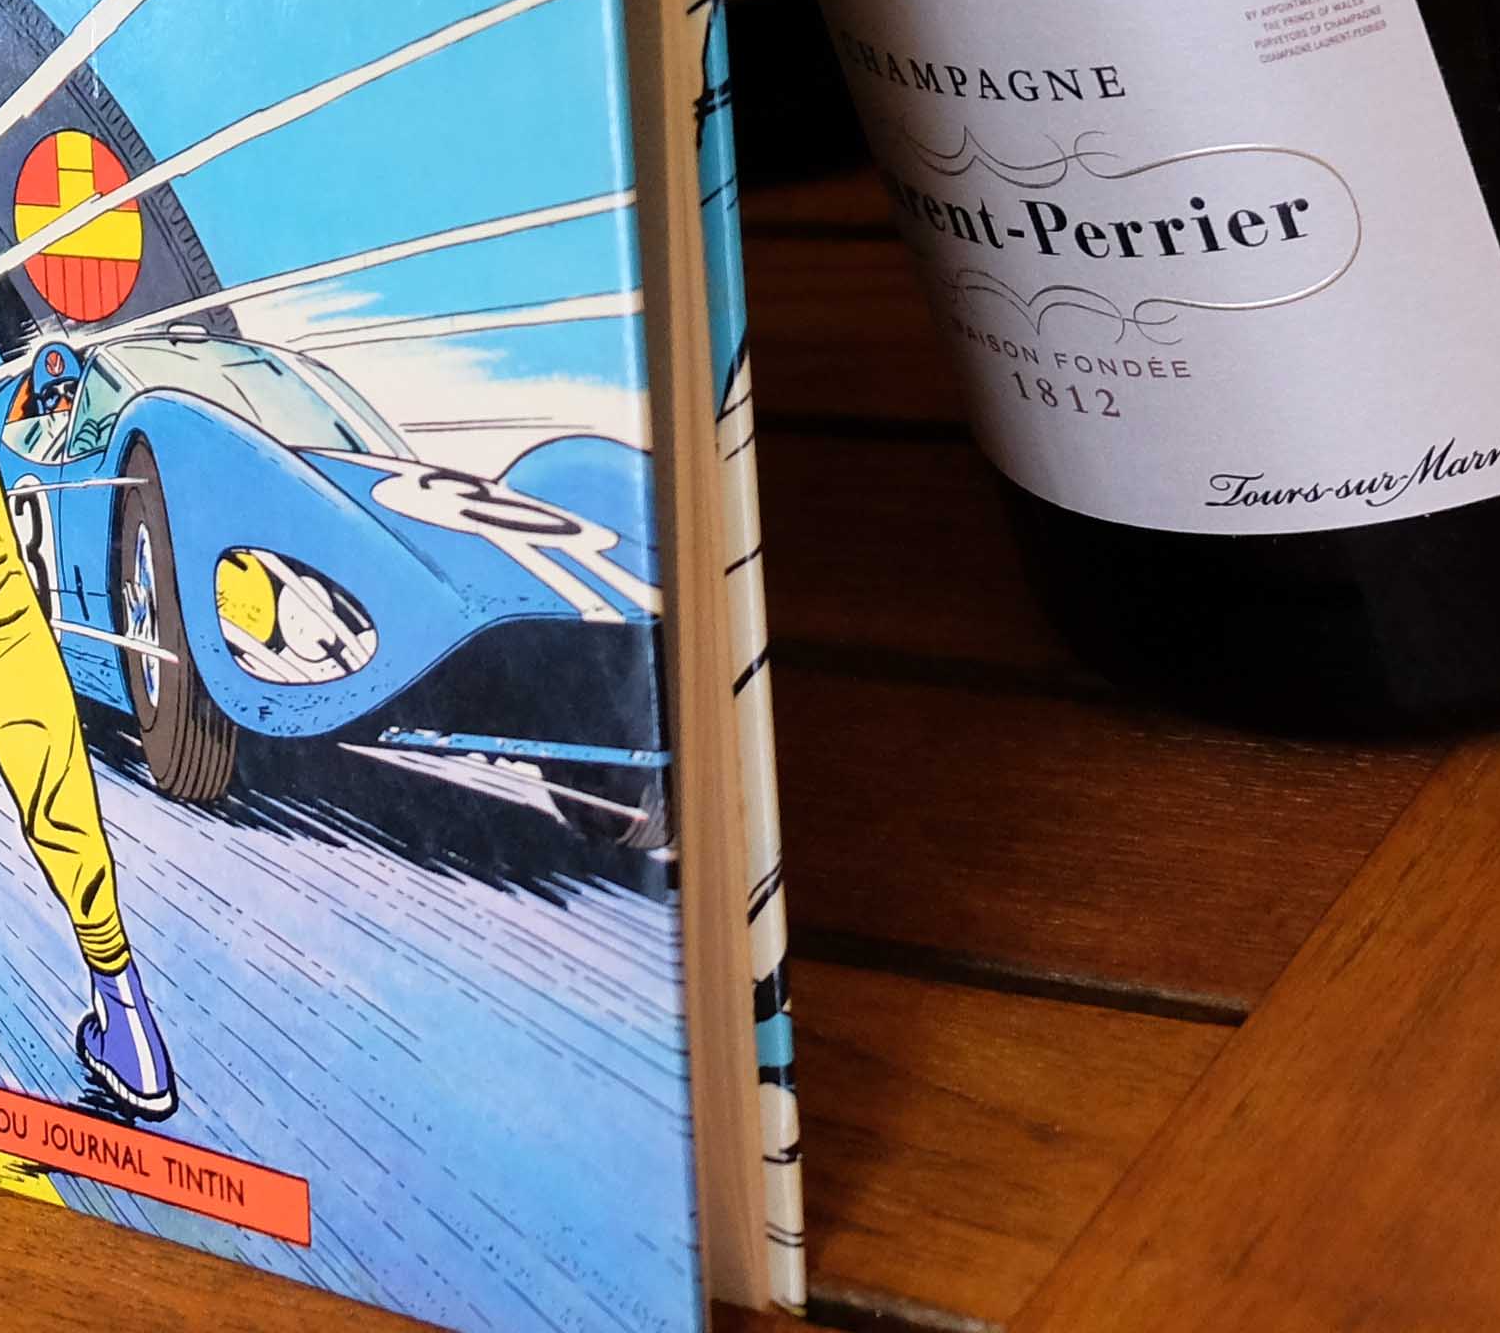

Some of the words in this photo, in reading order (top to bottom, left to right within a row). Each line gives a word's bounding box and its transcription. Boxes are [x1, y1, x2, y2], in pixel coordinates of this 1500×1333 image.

[1055, 352, 1192, 379] FONDÉE
[1012, 371, 1121, 418] 1812
[42, 1118, 150, 1178] JOURNAL
[163, 1156, 245, 1206] TINTIN
